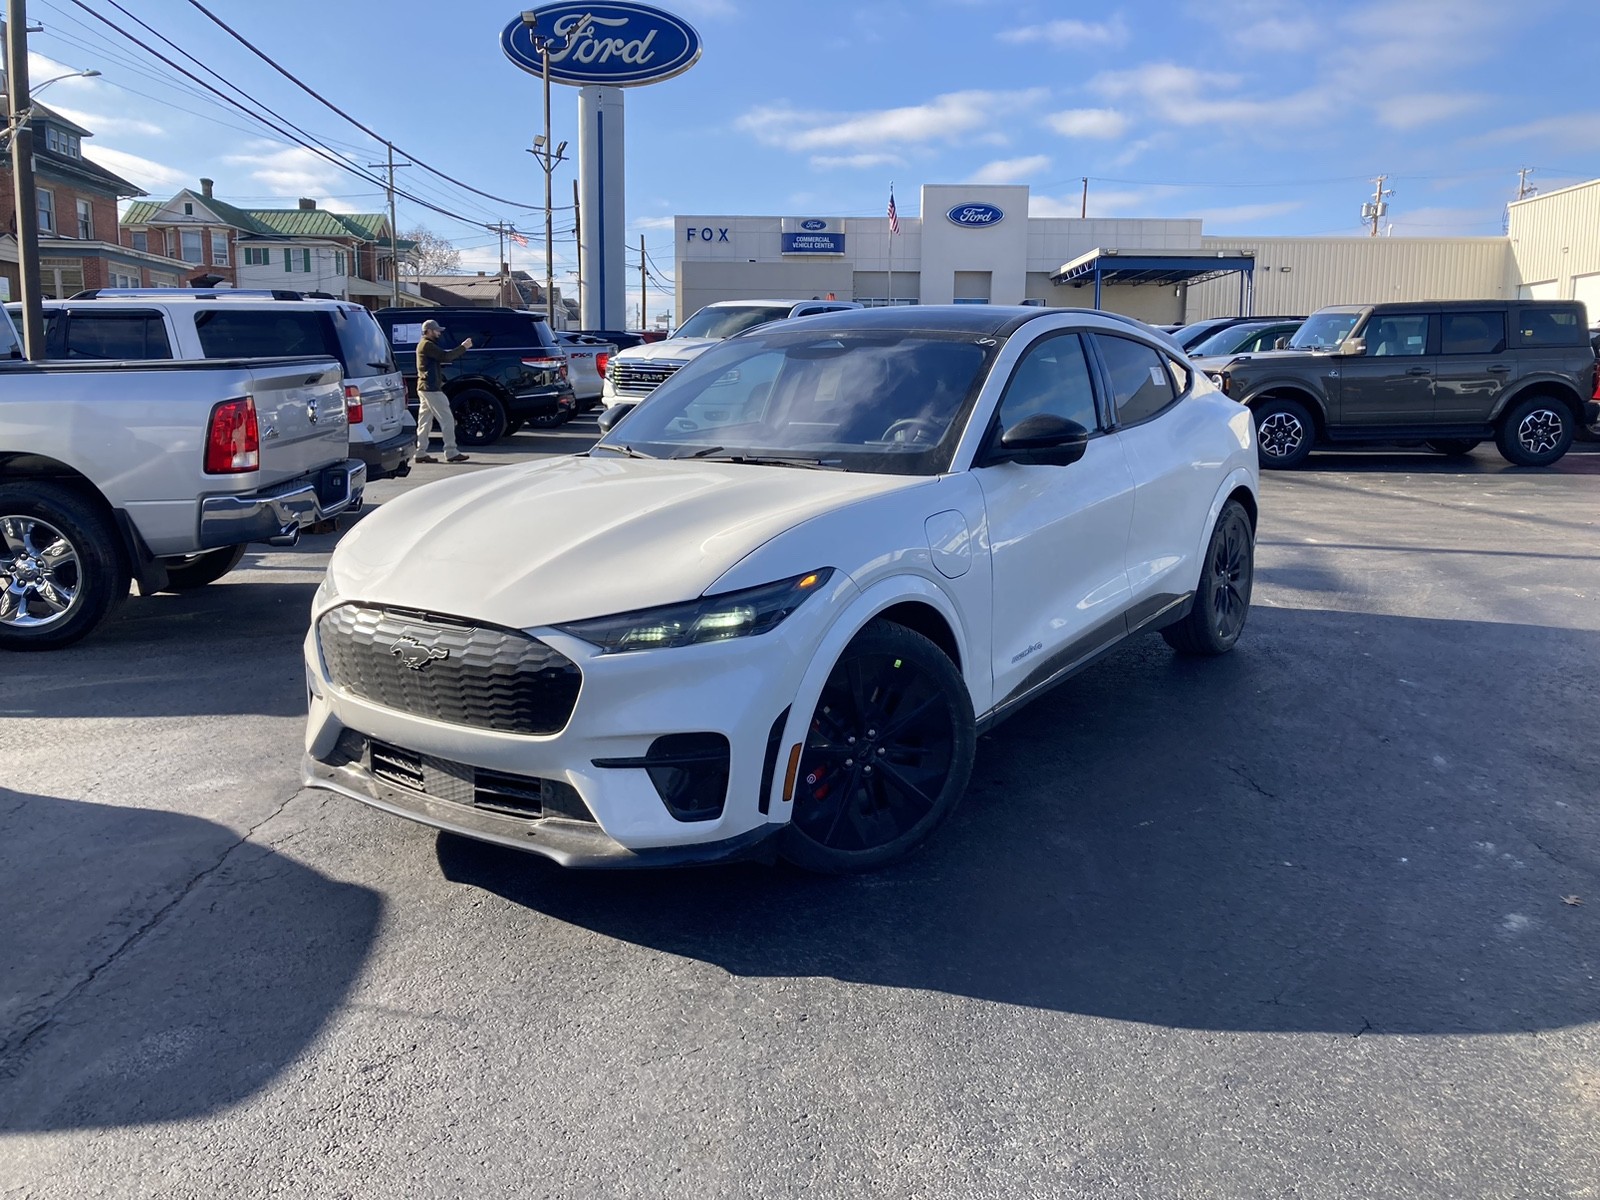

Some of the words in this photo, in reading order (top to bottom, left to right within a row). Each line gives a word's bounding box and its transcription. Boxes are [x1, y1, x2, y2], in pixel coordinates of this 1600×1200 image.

[545, 13, 658, 65] Ford
[960, 207, 993, 222] Ford
[805, 221, 822, 229] Ford
[687, 227, 729, 242] FOX
[631, 373, 664, 381] RAM
